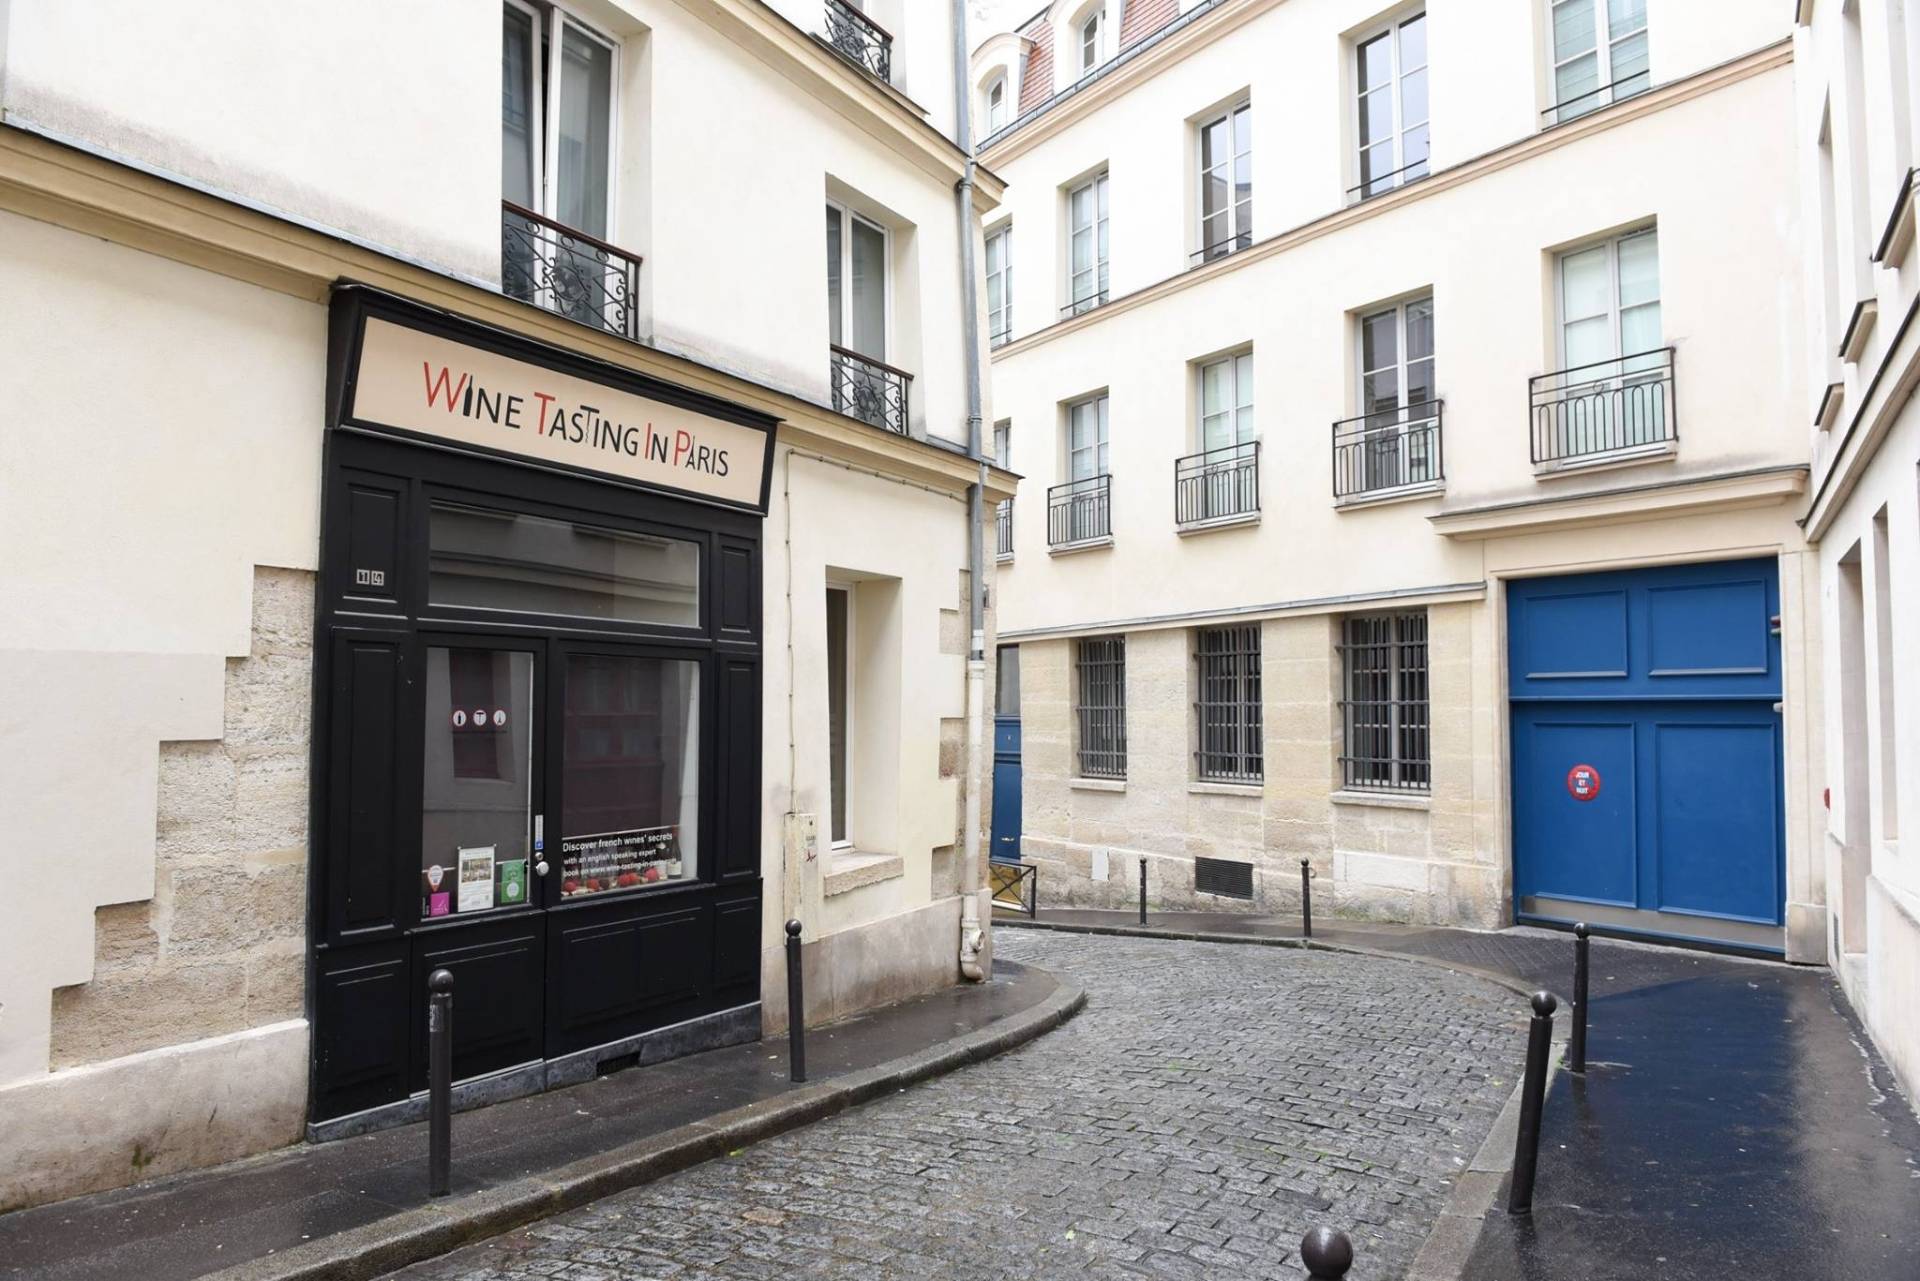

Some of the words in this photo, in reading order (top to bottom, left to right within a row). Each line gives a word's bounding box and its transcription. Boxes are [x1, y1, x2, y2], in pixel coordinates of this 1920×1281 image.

[424, 362, 523, 429] WINE
[534, 391, 639, 456] TASTING
[644, 422, 668, 464] IN
[673, 430, 729, 477] PARIS
[562, 842, 597, 852] Discover
[599, 837, 622, 848] french
[624, 835, 647, 845] wines'
[648, 832, 673, 842] secrets
[563, 857, 578, 865] with
[579, 856, 587, 864] an
[587, 853, 610, 865] english
[611, 850, 638, 860] speaking
[639, 848, 657, 858] expert
